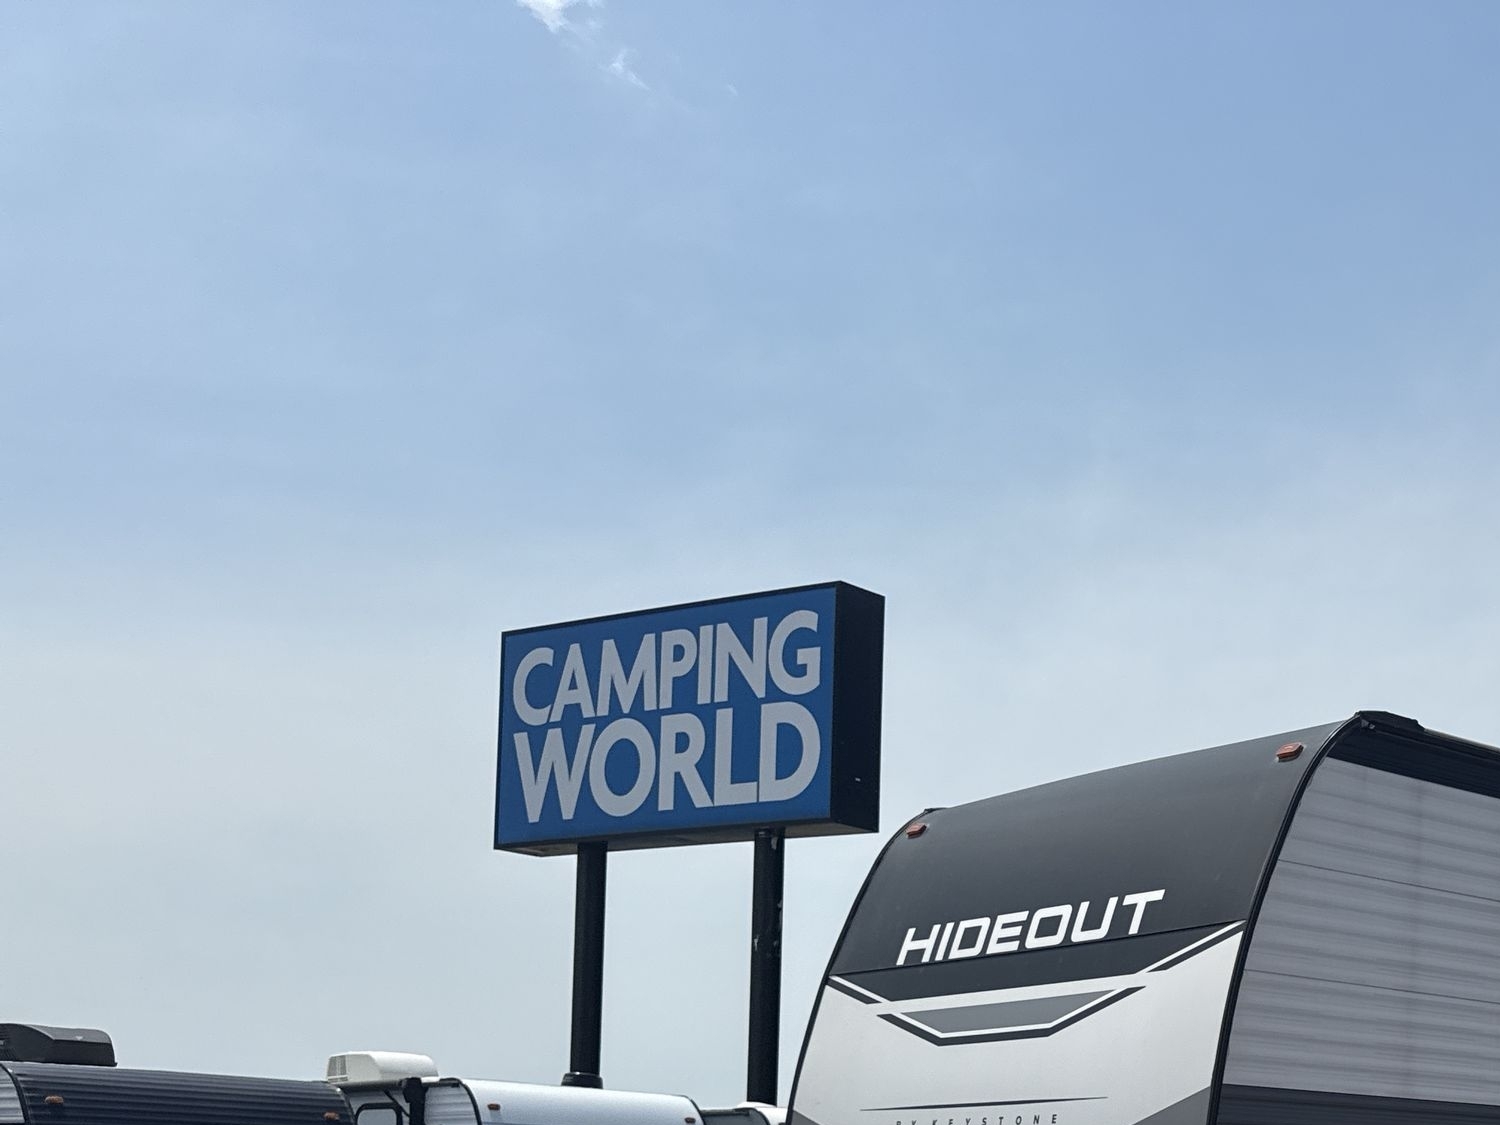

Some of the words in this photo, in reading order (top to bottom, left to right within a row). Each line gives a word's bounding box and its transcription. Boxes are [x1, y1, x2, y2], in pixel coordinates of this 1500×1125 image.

[512, 609, 822, 726] CAMPING
[513, 701, 821, 824] WORLD
[895, 888, 1166, 966] HIDEOUT
